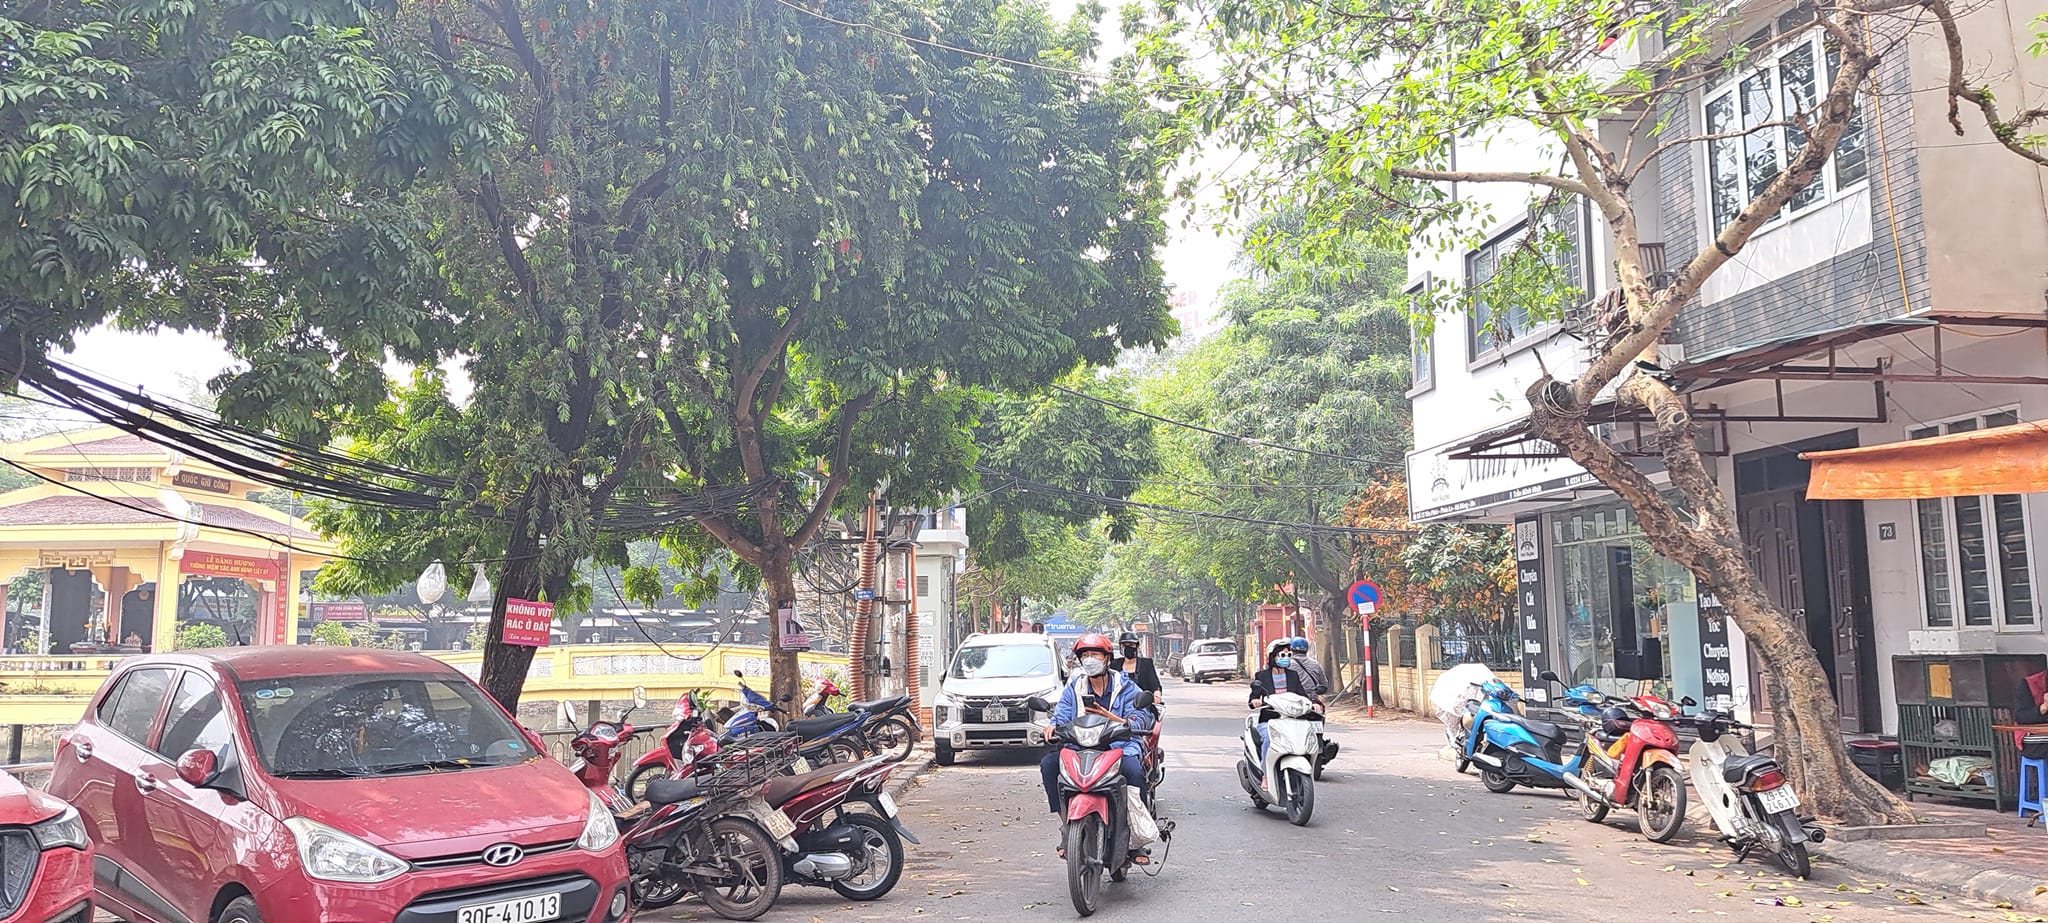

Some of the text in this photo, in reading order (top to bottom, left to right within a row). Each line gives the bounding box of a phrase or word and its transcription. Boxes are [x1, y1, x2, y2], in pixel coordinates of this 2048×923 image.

[181, 473, 199, 485] QUỐC
[1881, 525, 1893, 538] 73
[1520, 568, 1538, 586] Chuyên
[1698, 593, 1711, 611] Tạo
[507, 603, 553, 618] KHÔNG VỨT
[506, 618, 550, 632] RÁC Ở ĐÂY
[1703, 643, 1728, 661] Chuyên
[1706, 668, 1729, 687] Nghiệp
[1766, 796, 1798, 812] 246.11
